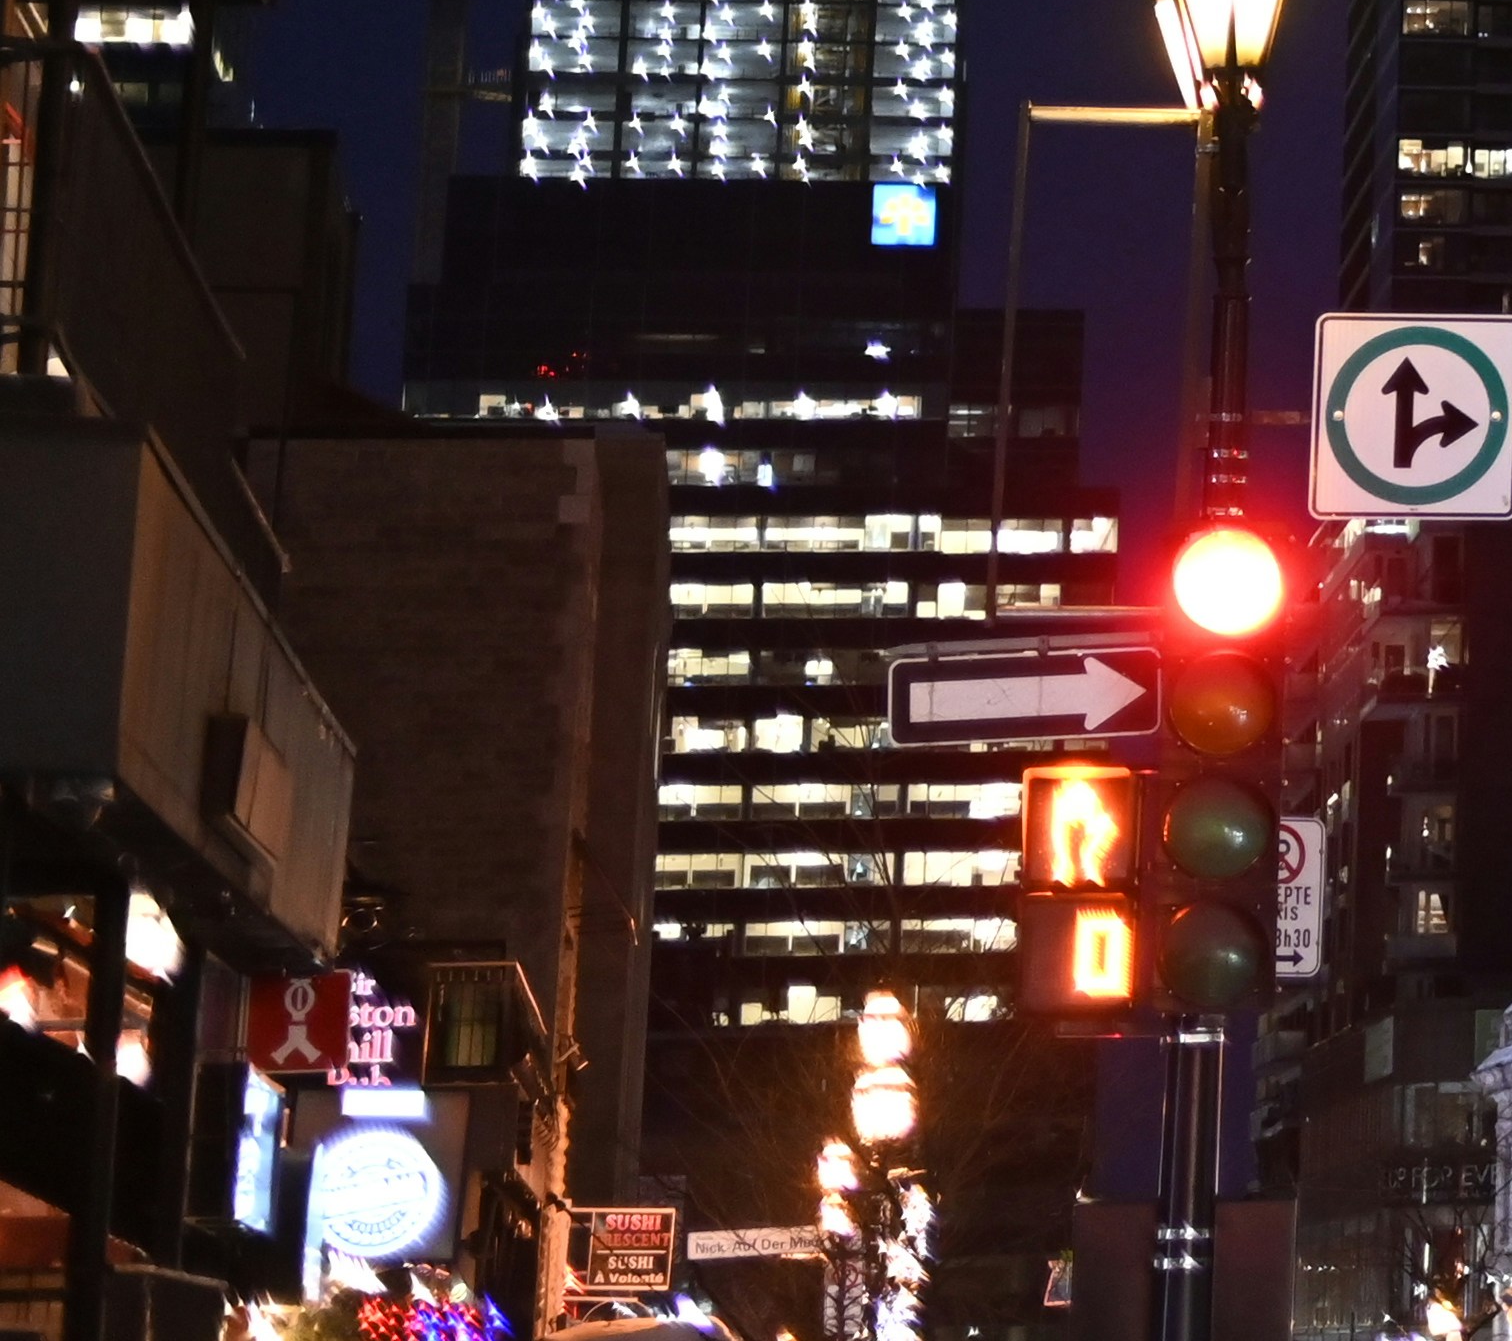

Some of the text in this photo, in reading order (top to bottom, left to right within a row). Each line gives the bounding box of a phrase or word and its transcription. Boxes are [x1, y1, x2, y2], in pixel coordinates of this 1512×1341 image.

[606, 1214, 662, 1231] SUSHI
[761, 1238, 786, 1251] Der
[608, 1256, 654, 1270] SUSHI
